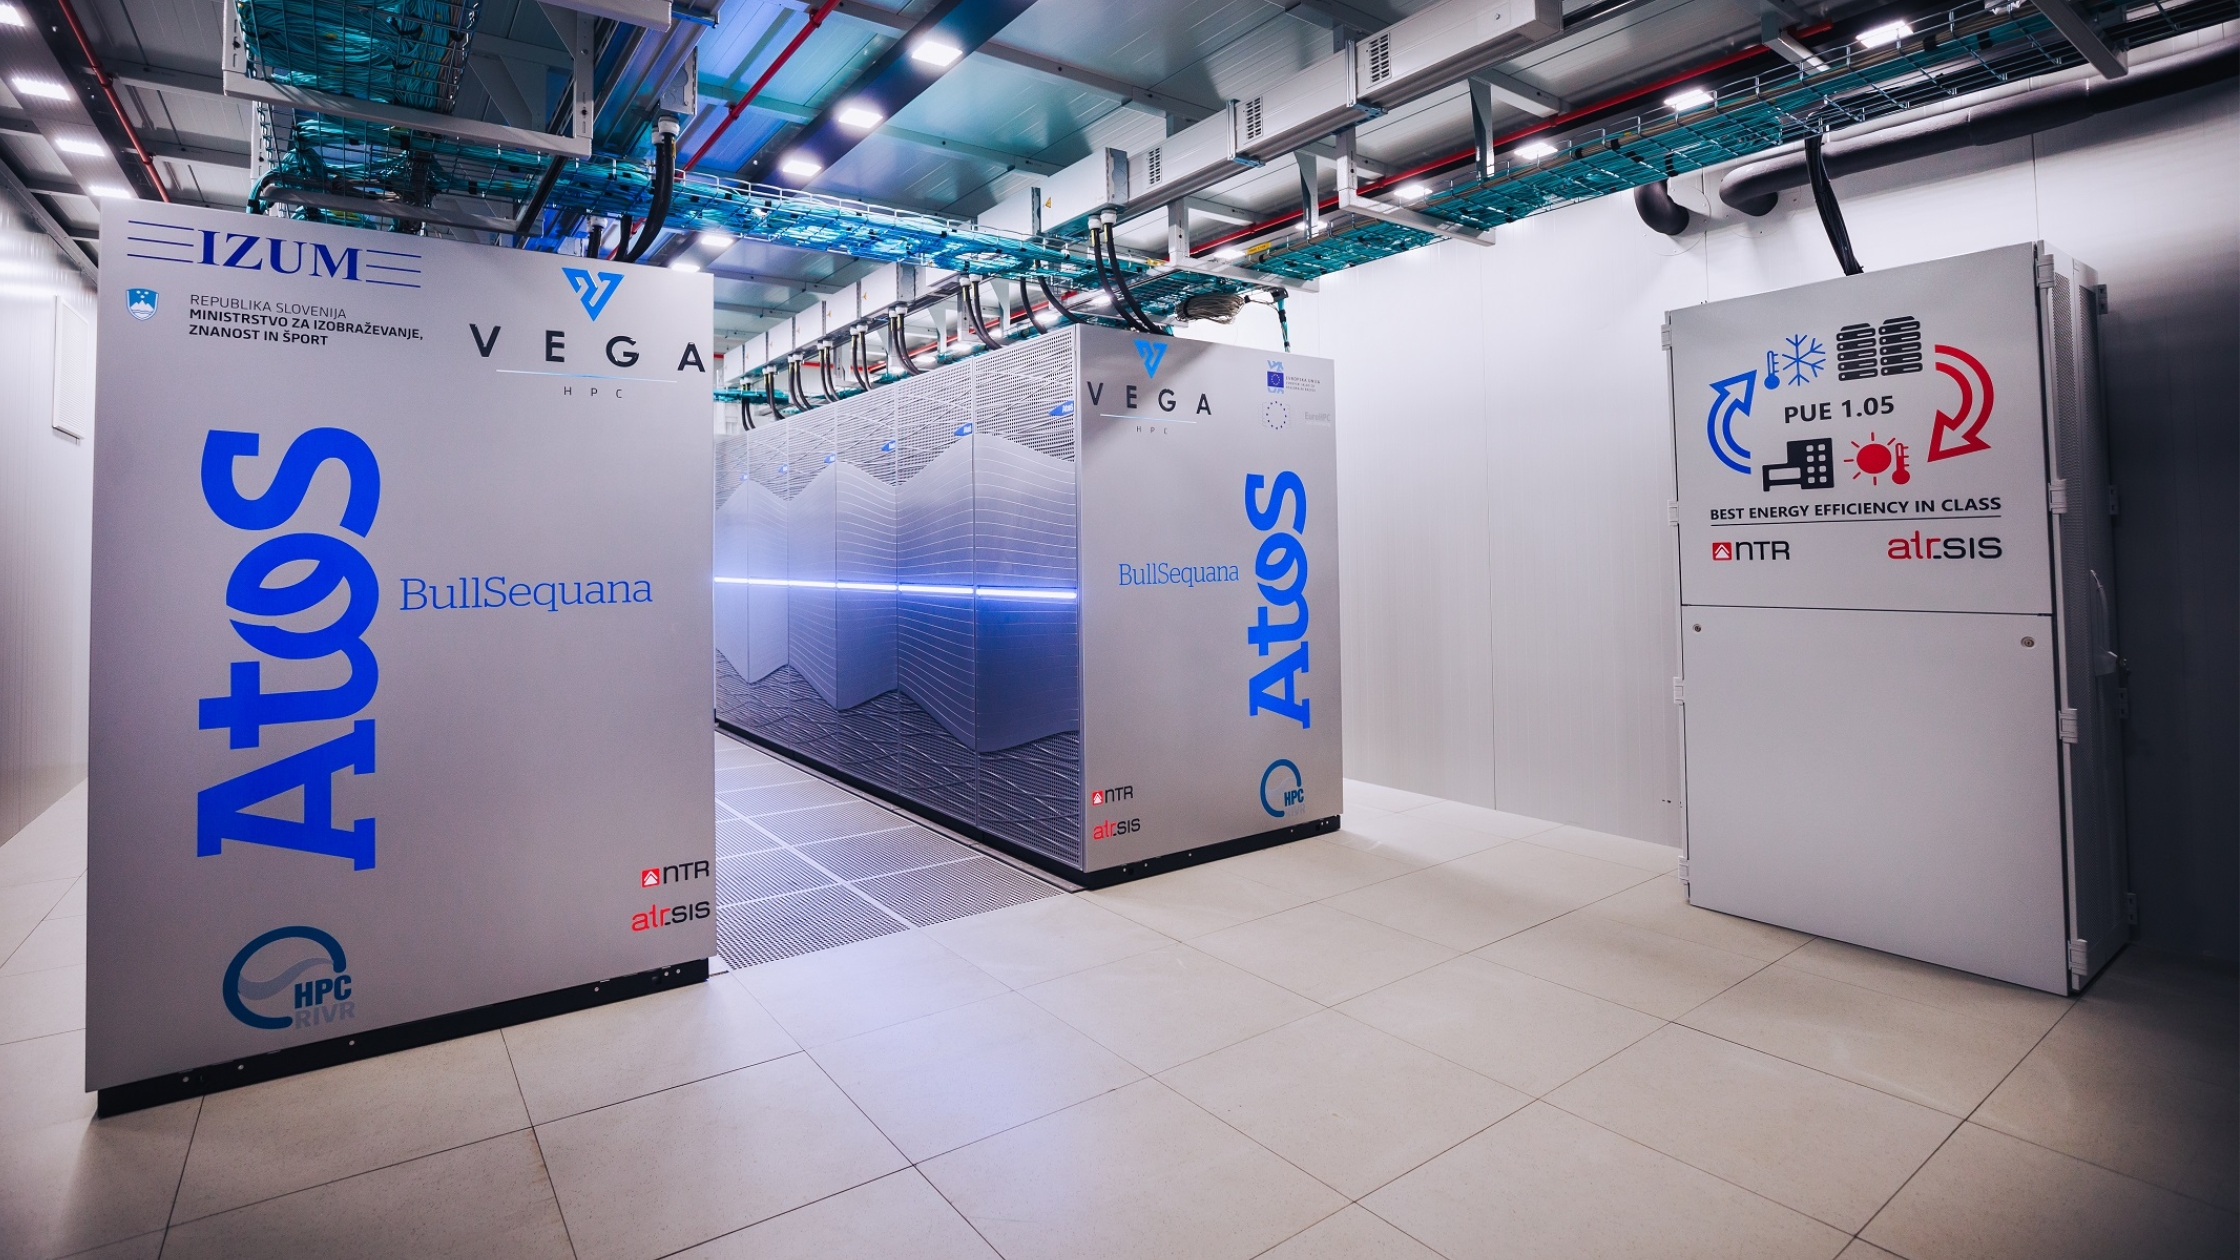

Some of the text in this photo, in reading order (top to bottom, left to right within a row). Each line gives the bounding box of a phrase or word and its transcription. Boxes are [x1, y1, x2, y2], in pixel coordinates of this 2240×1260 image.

[197, 229, 363, 282] IZUM
[190, 294, 347, 320] REPUBLIKA SLOVENIJA
[189, 309, 424, 341] MINISTRSTVO ZA IZOBRAŽEVANJE,
[189, 324, 328, 346] ZNANOST IN ŠPORT
[469, 323, 706, 373] VEGA
[564, 386, 623, 399] HPC
[1087, 381, 1212, 416] VEGA
[1784, 395, 1895, 424] PUE 1.05
[1710, 497, 2002, 521] BEST ENERGY EFFICIENCY IN CLASS
[1118, 563, 1239, 587] BullSequana
[399, 576, 653, 612] BullSequana
[1284, 788, 1304, 807] HPC
[295, 975, 352, 1009] HPC
[295, 1001, 356, 1029] RIVR
